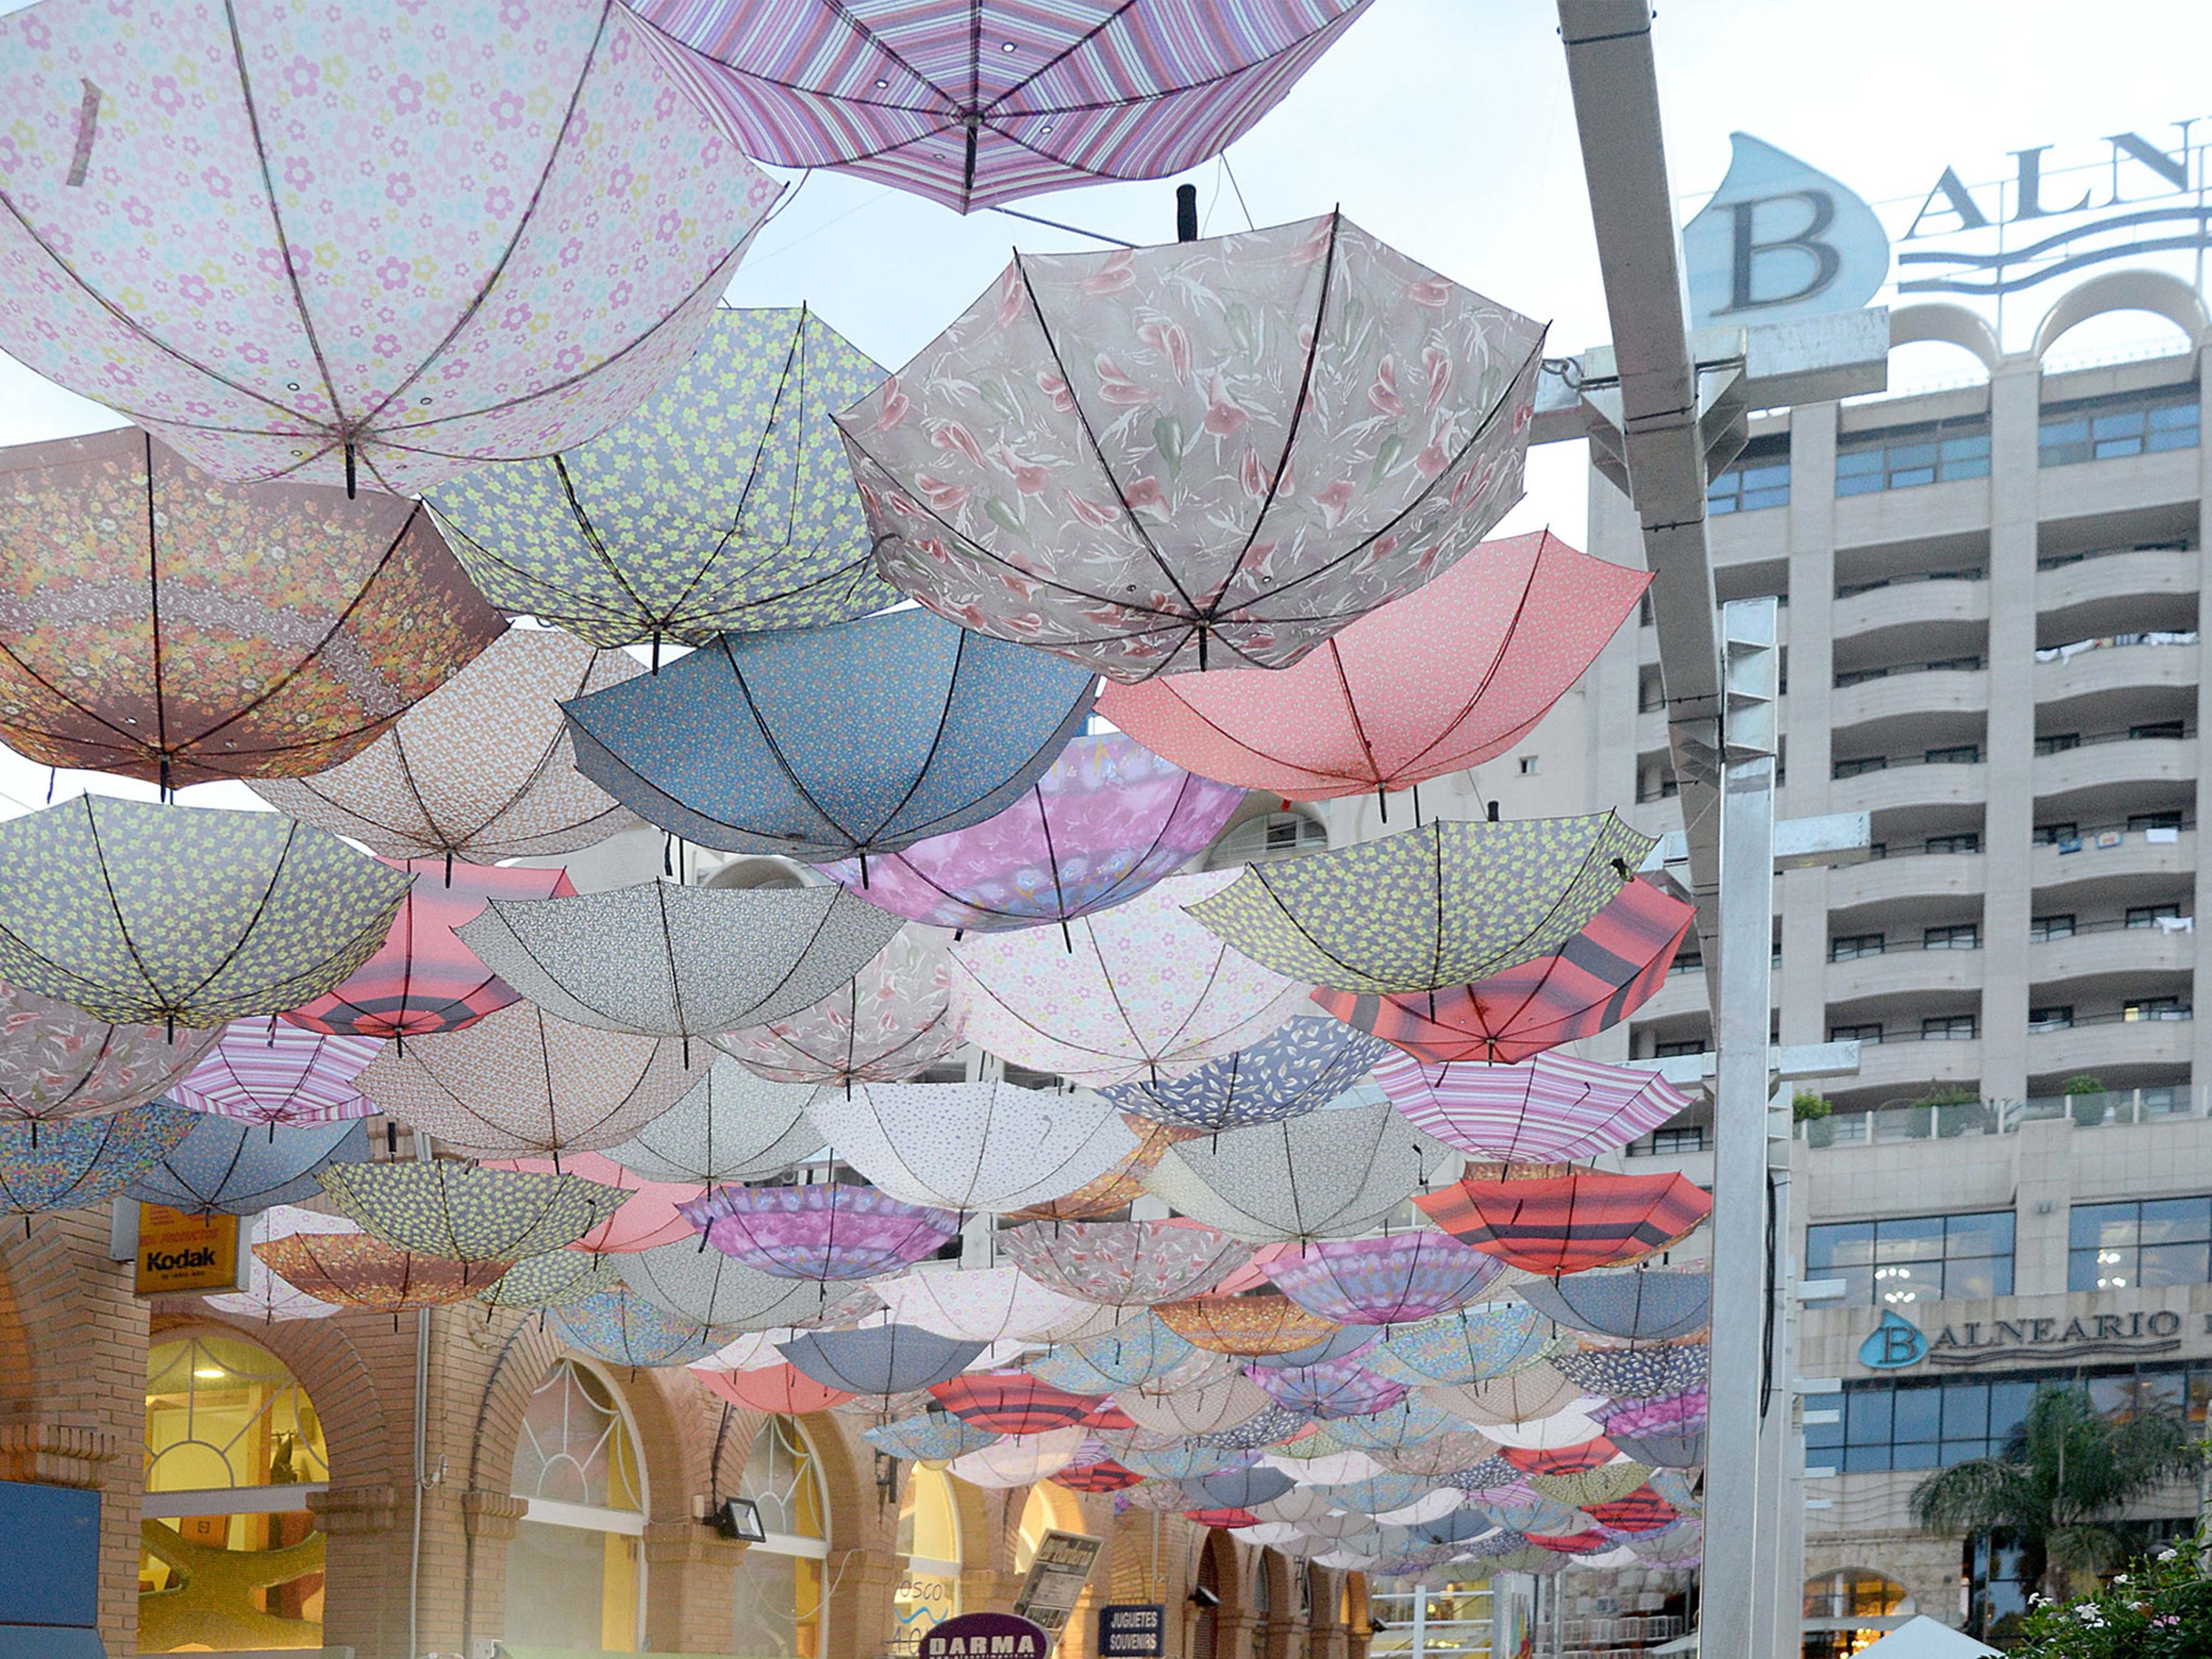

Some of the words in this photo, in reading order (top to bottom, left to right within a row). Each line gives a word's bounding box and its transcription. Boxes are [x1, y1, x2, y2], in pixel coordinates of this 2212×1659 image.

[1709, 115, 2212, 317] BALN
[147, 1247, 216, 1272] Kodak
[1877, 1310, 2181, 1363] BALNEARIO
[1110, 1611, 1158, 1628] JUGUETES
[929, 1635, 1034, 1655] DARMA
[1110, 1632, 1157, 1650] SOUVENIRS
